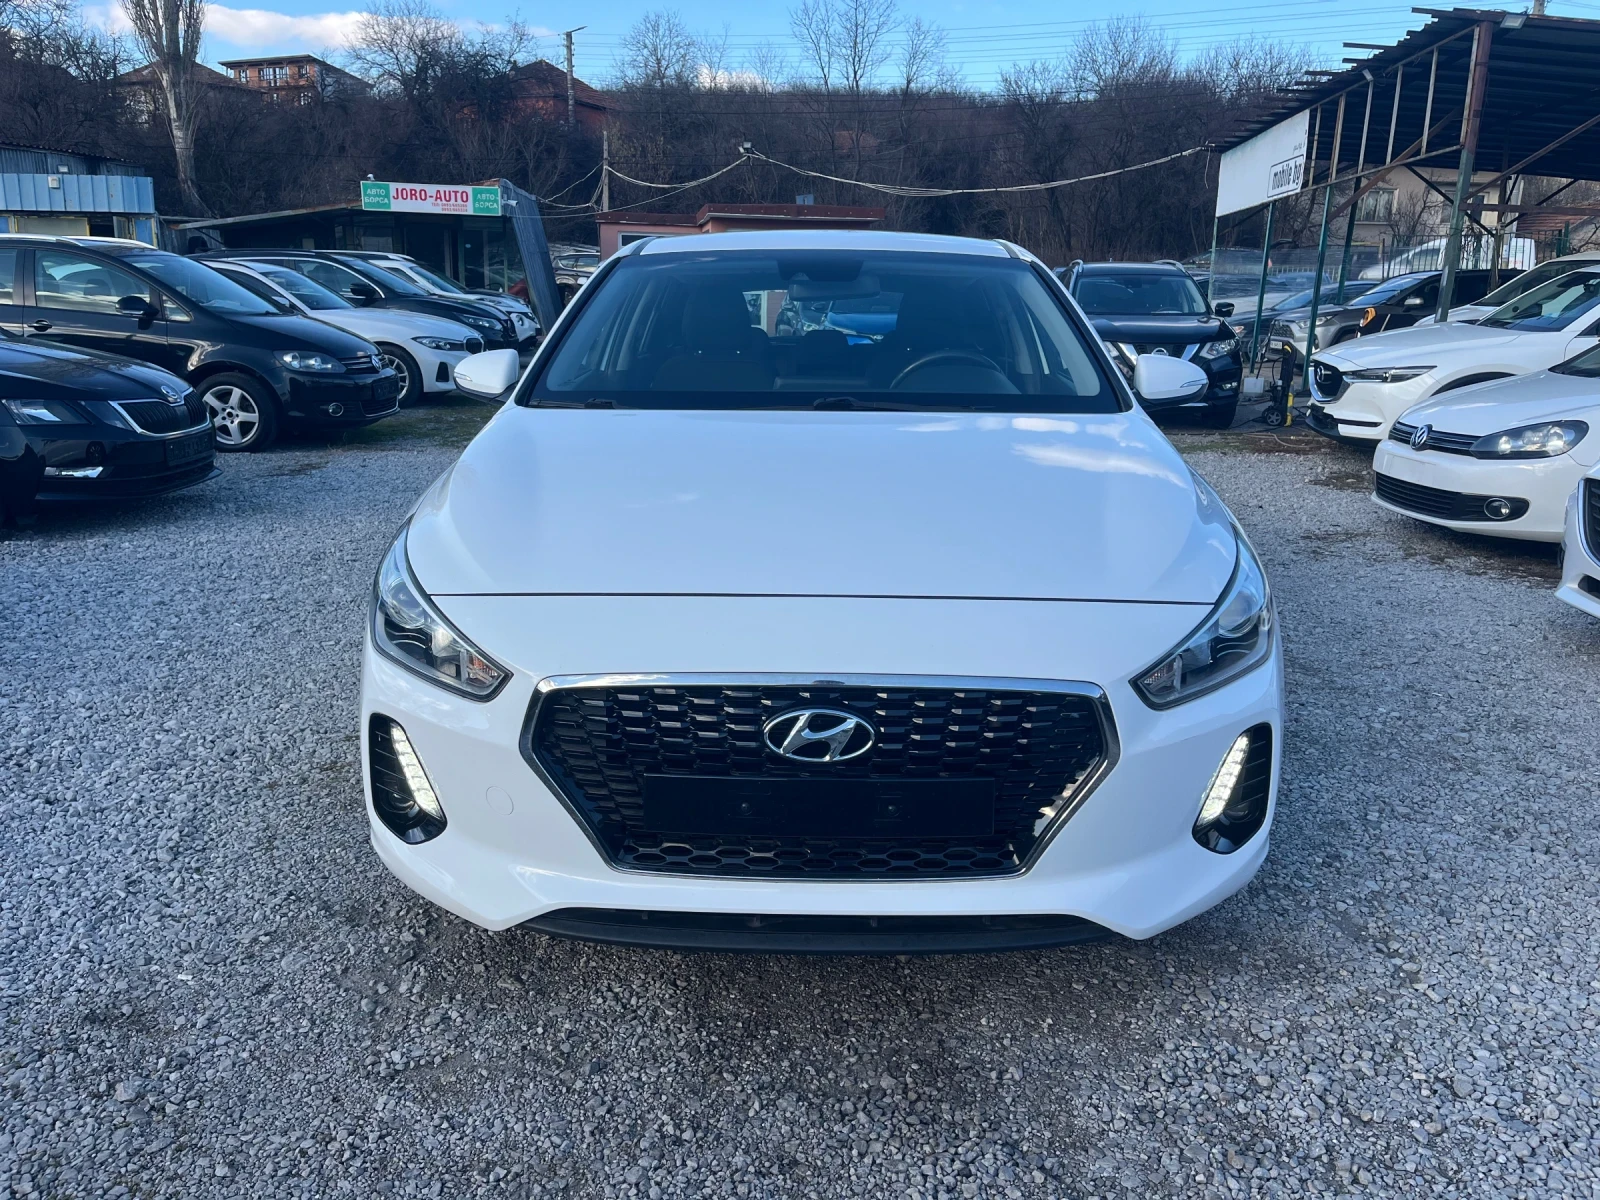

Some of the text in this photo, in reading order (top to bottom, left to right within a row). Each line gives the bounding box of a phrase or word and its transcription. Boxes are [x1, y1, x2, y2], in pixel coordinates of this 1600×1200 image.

[366, 188, 386, 196] АВТО
[392, 187, 469, 204] JORO-AUTO
[364, 196, 389, 204] БОРСА
[474, 201, 499, 209] БОРСА
